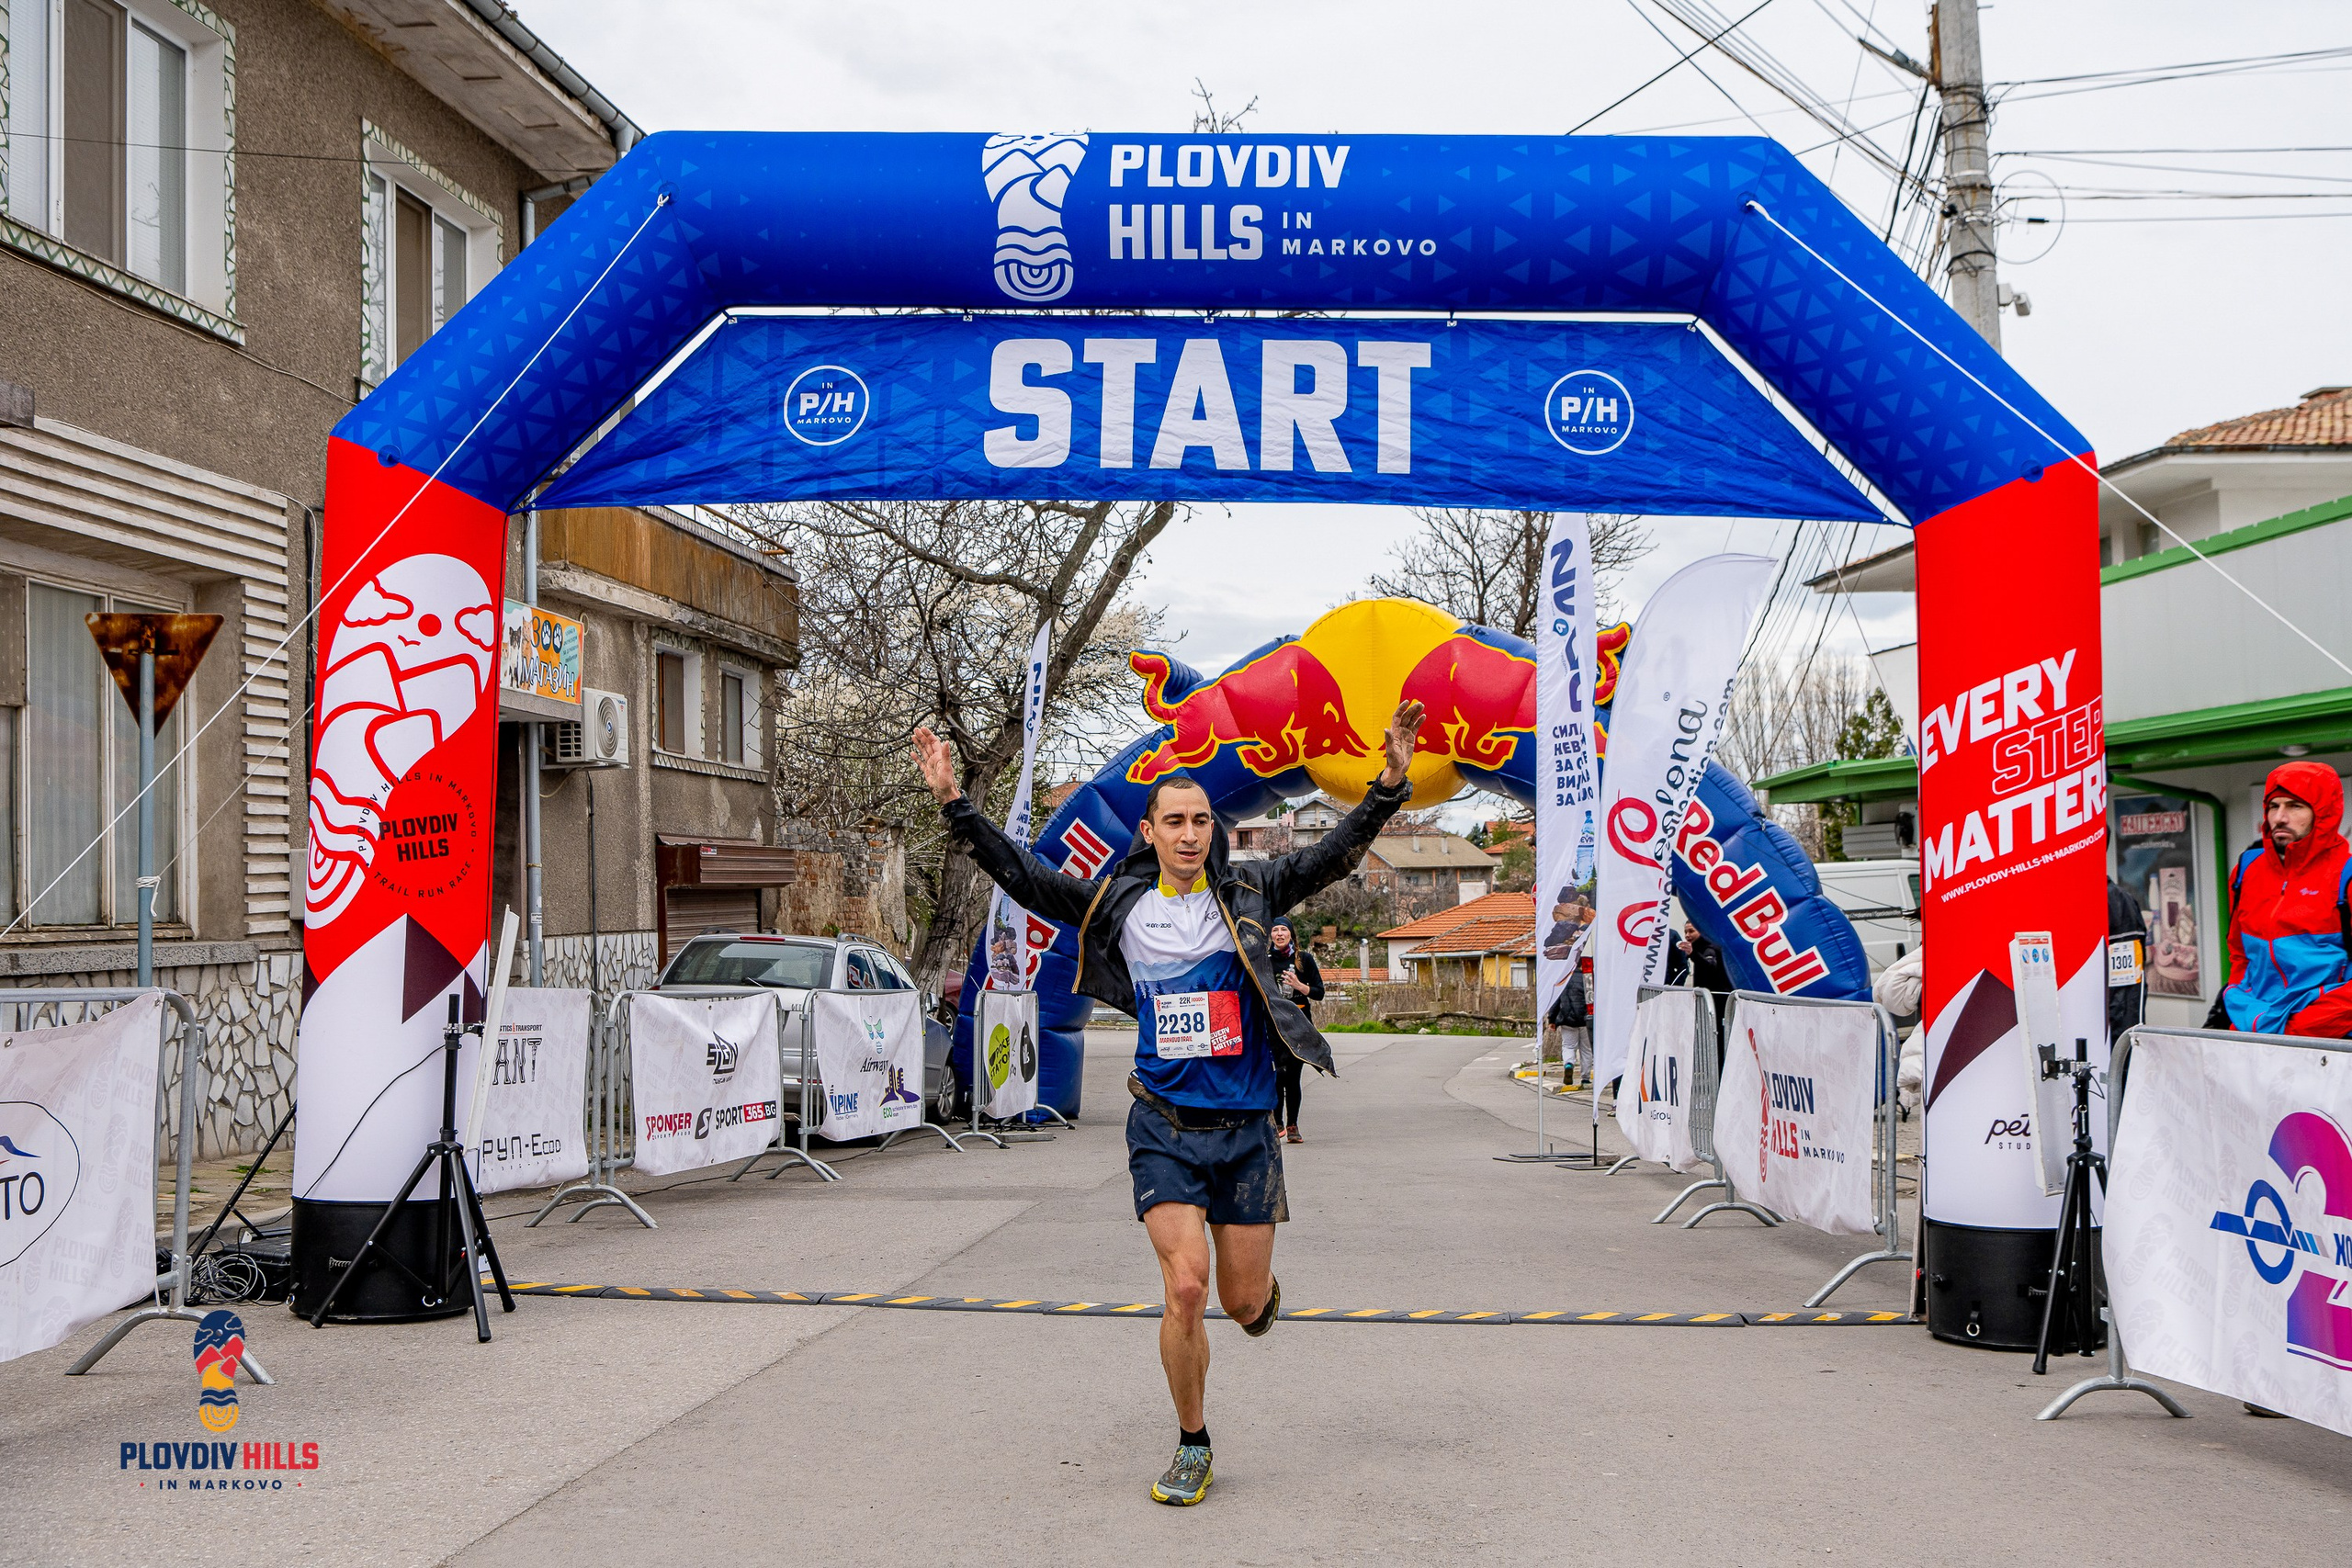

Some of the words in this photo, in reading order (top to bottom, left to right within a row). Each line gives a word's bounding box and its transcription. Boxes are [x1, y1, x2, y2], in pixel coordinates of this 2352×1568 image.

[1110, 145, 1351, 188] PLOVDIV
[1109, 204, 1263, 260] HILLS
[1282, 212, 1312, 229] IN
[1282, 239, 1437, 256] MARKOVO
[799, 391, 854, 416] P/H
[983, 339, 1432, 474] START
[1562, 396, 1617, 424] P/H
[1562, 425, 1617, 434] MARKOVO
[521, 656, 575, 697] МАГАЗИН
[1921, 649, 2076, 775] EVERY
[1992, 694, 2103, 795] STEP
[1555, 759, 1574, 773] ЗА
[357, 793, 379, 852] PLOVDIV
[380, 773, 422, 793] HILLS
[429, 773, 443, 783] IN
[447, 781, 477, 838] MARKOVO
[1556, 793, 1576, 807] ЗА
[379, 813, 458, 840] PLOVDIV
[396, 838, 449, 863] HILLS
[373, 871, 410, 897] TRAIL
[418, 887, 445, 898] RUN
[448, 861, 471, 889] RACE
[1674, 797, 1766, 906] Red
[1731, 891, 1826, 994] Bull
[2111, 955, 2132, 970] 1302
[1159, 1011, 1205, 1034] 2238
[646, 1112, 692, 1141] SPONSER
[1801, 1129, 1811, 1141] IN
